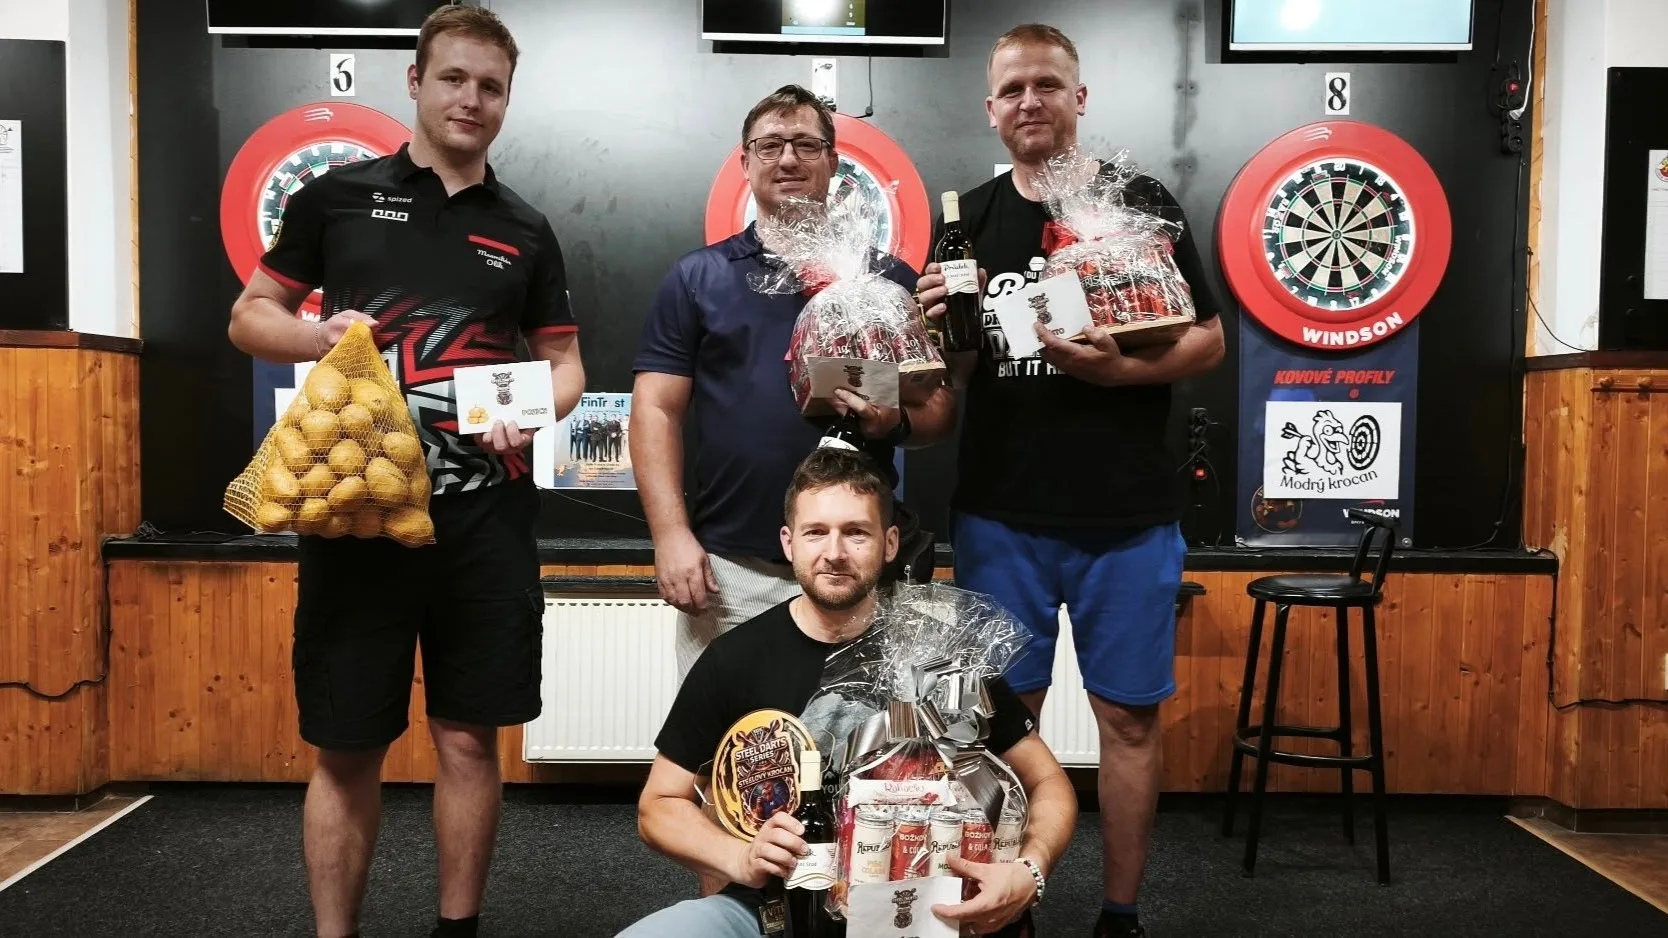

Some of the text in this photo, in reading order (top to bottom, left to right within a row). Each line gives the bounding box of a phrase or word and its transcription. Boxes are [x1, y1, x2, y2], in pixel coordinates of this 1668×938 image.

[333, 57, 352, 92] 6
[1328, 77, 1347, 111] 8
[1302, 311, 1403, 345] WINDSON
[998, 360, 1020, 377] BUT
[1026, 360, 1041, 376] IT
[1274, 367, 1396, 385] KOVOVÉ PROFILY
[1280, 474, 1325, 493] Modrý
[1328, 470, 1378, 490] krocan
[736, 736, 787, 761] STEEL DARTS
[750, 751, 775, 764] SERIES
[767, 765, 793, 777] KROCAN
